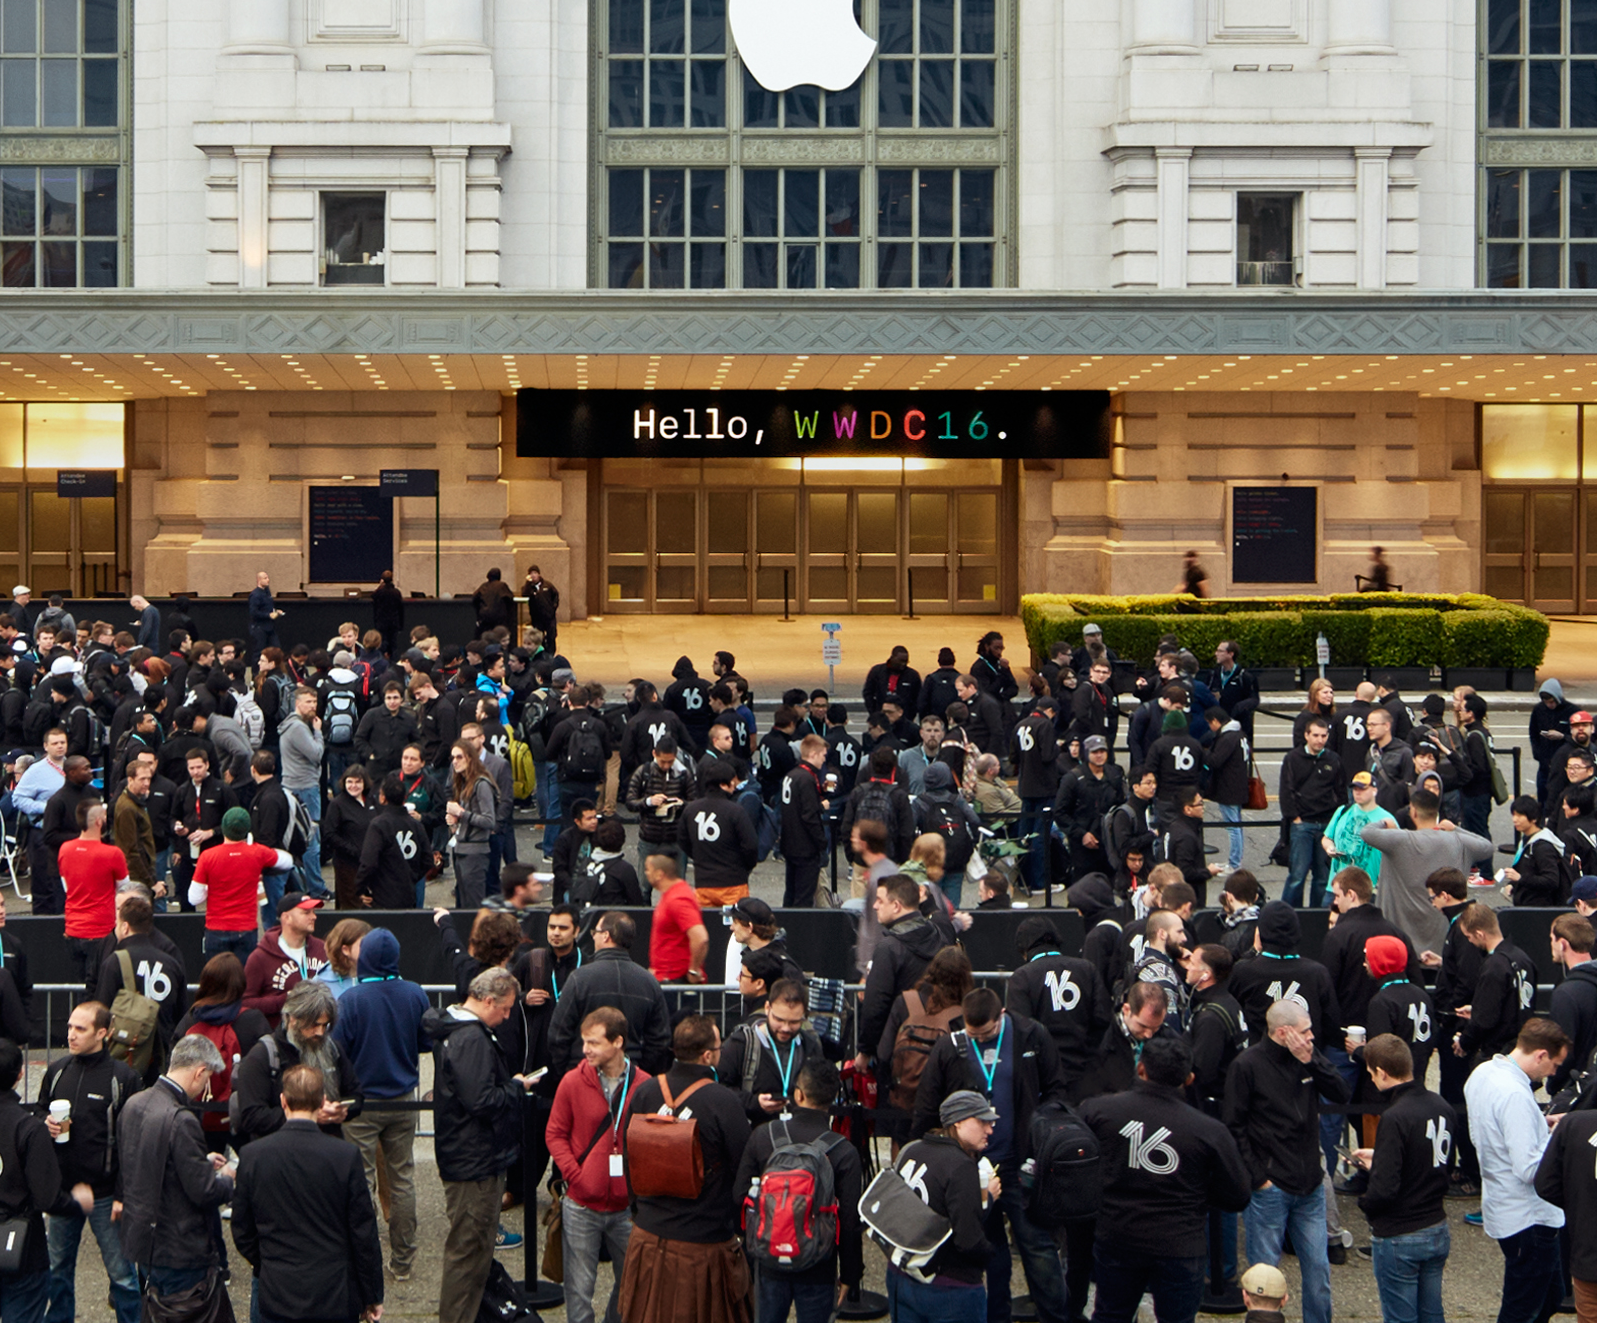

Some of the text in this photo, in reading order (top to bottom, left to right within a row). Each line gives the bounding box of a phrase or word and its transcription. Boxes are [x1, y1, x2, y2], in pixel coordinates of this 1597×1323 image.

[633, 408, 1008, 445] Hello, WWDC16.
[683, 687, 703, 710] 16
[735, 722, 747, 746] 16
[1017, 725, 1035, 752] 16
[1344, 715, 1365, 741] 16
[489, 734, 509, 756] 16
[836, 742, 856, 767] 16
[1171, 746, 1194, 771] 16
[694, 812, 721, 841] 16
[136, 960, 172, 1001] 16
[1044, 970, 1081, 1011] 16
[1407, 1001, 1431, 1042] 16
[1119, 1120, 1180, 1175] 16
[1425, 1115, 1451, 1168] 16
